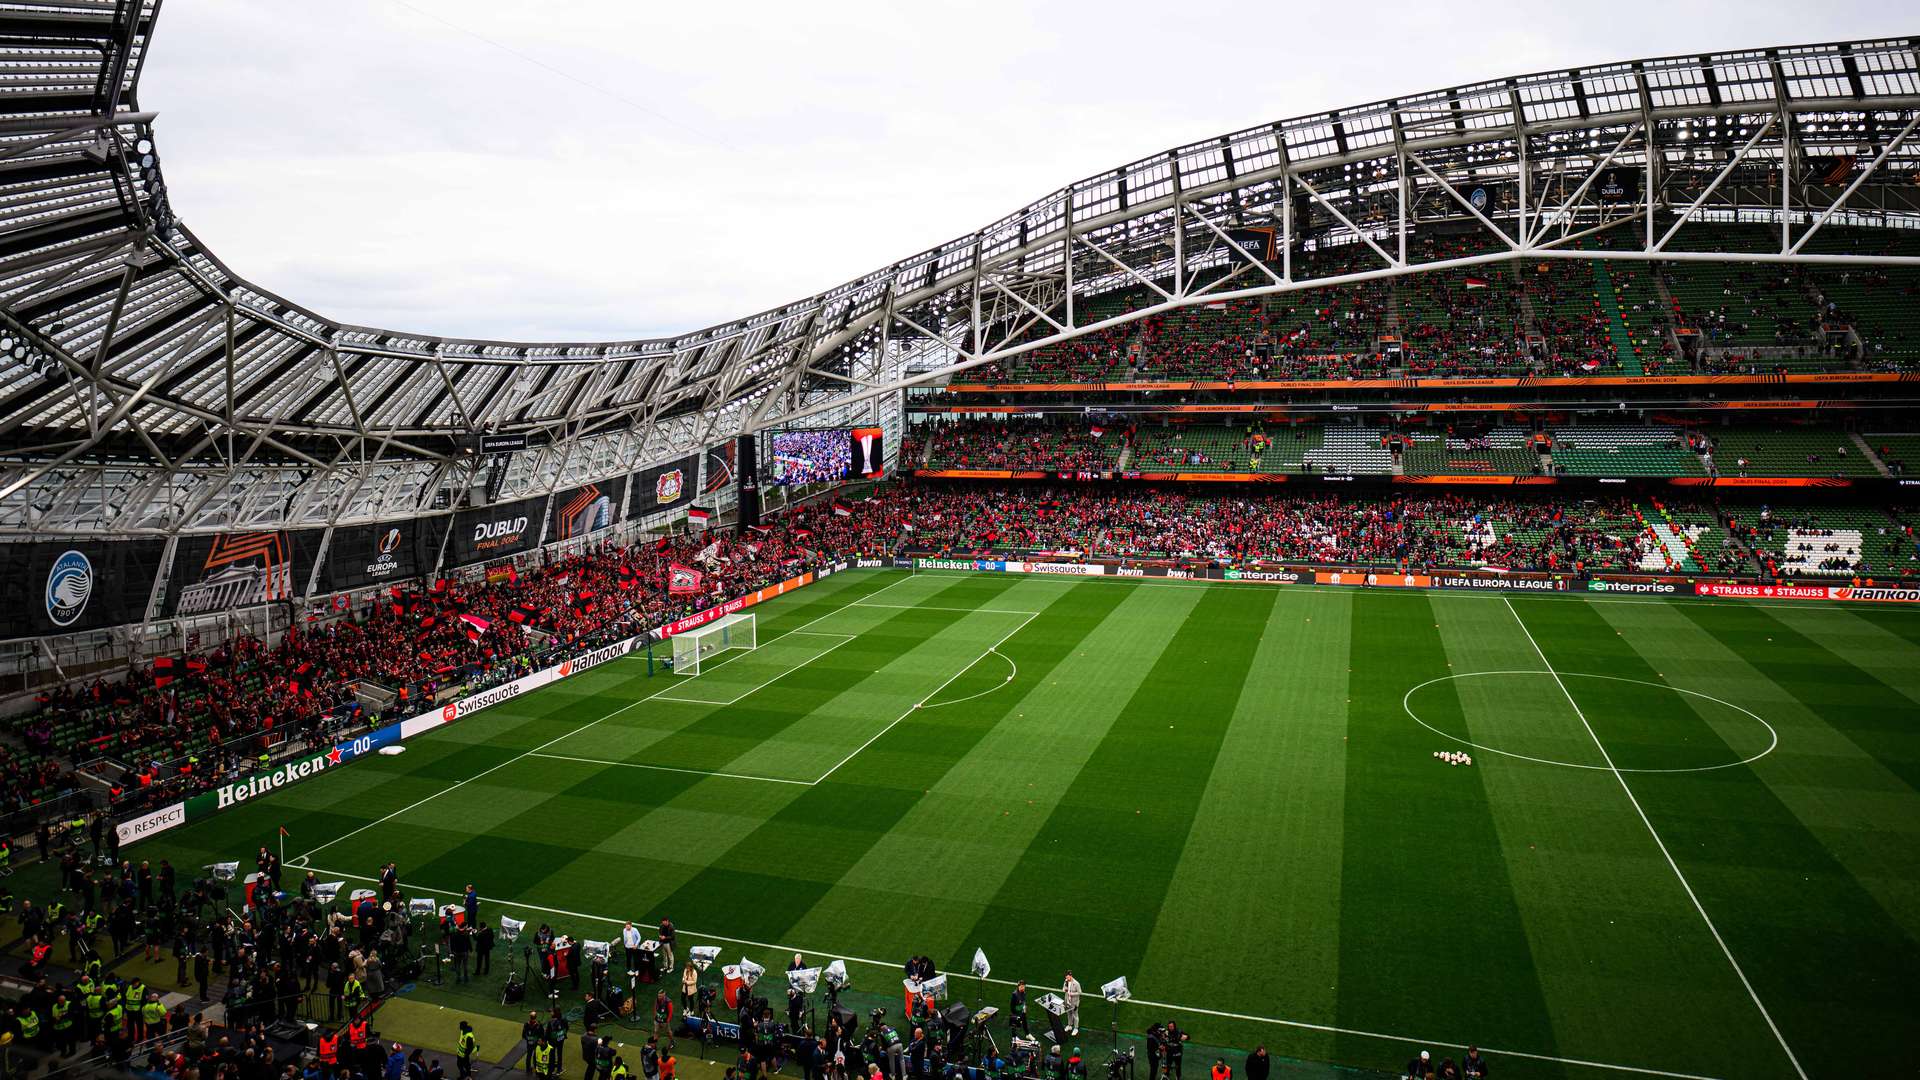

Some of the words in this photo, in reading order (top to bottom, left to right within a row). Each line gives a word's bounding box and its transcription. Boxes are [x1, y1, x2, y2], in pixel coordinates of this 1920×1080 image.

[476, 540, 499, 551] FINAL
[56, 561, 89, 572] ATALANTA
[367, 561, 398, 573] EUROPA
[857, 559, 882, 568] bwin
[918, 558, 970, 570] Heineken
[1034, 563, 1087, 574] Swissquote
[1116, 566, 1144, 576] bwin
[1227, 570, 1299, 582] enterprise
[1444, 577, 1471, 587] UEFA
[1473, 579, 1512, 588] EUROPA
[1513, 580, 1553, 589] LEAGUE
[1591, 581, 1675, 593] enterprise
[1712, 586, 1759, 595] STRAUSS
[1776, 588, 1824, 597] STRAUSS
[57, 608, 76, 618] 1907
[678, 614, 704, 631] STRAUSS
[458, 682, 520, 716] Swissquote
[216, 757, 325, 809] Heineken
[134, 808, 183, 835] RESPECT
